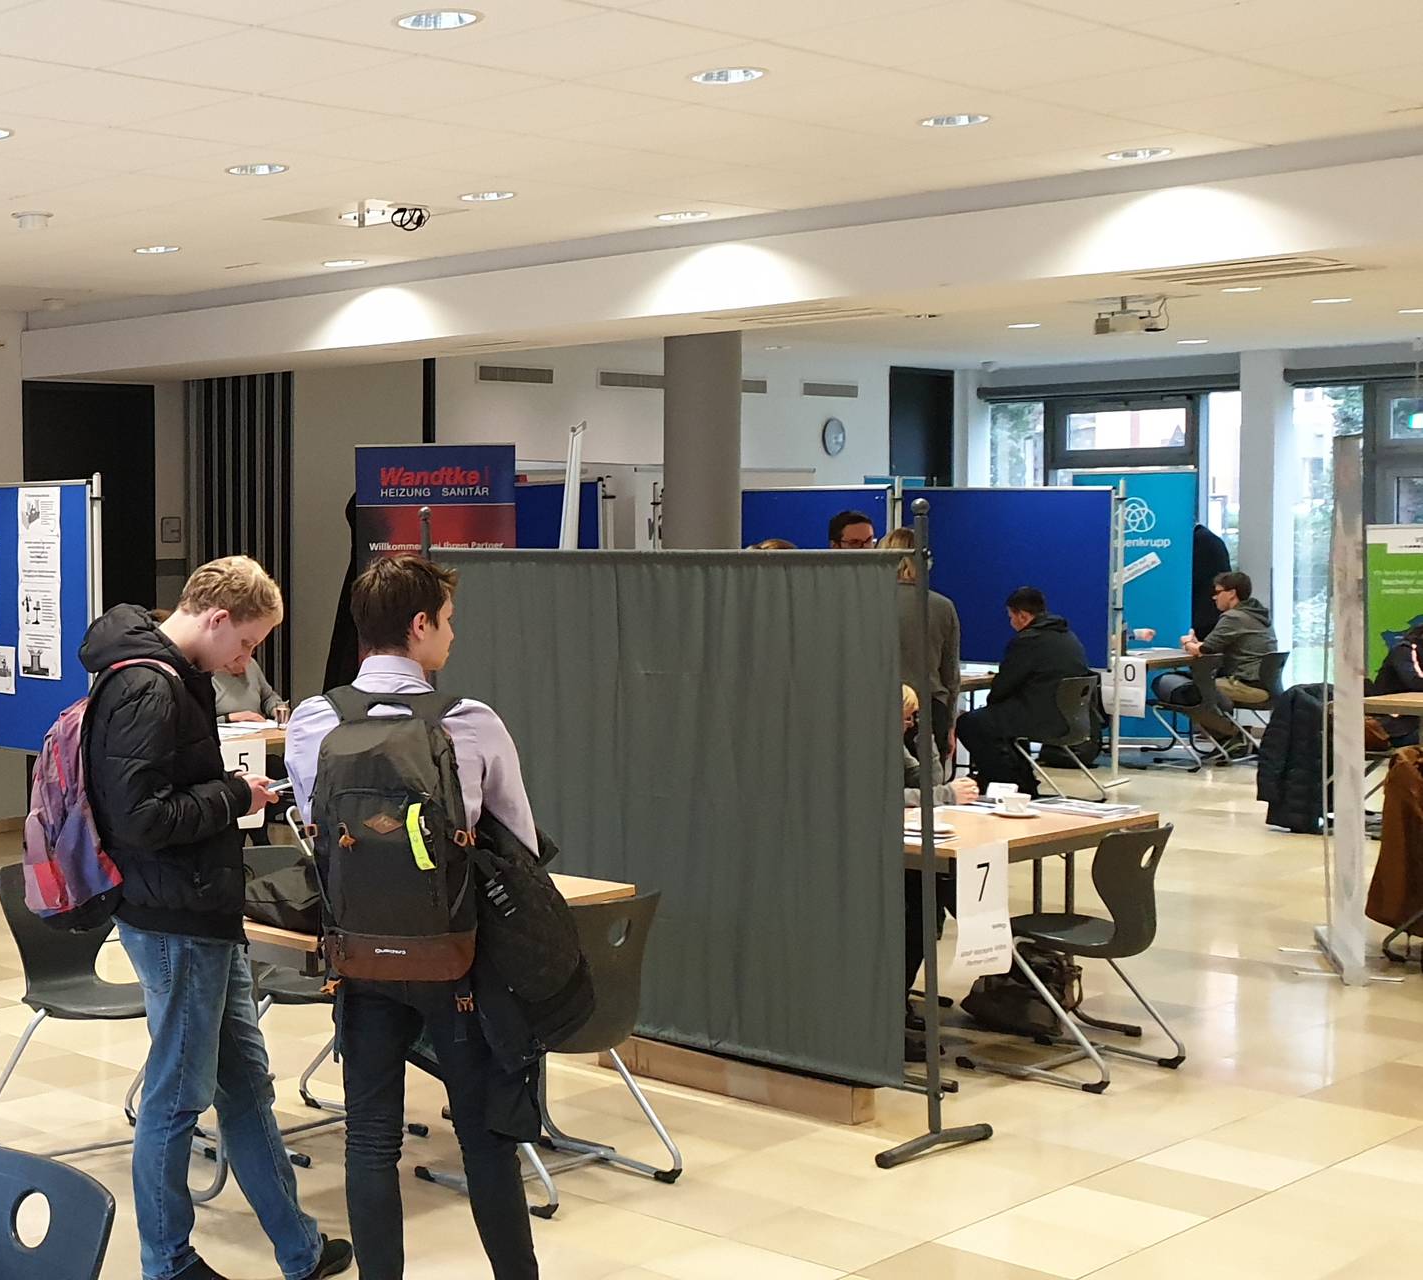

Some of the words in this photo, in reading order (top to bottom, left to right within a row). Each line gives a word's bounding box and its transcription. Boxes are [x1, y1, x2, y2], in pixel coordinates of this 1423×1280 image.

[380, 465, 480, 486] Wandtke
[380, 487, 431, 498] HEIZUNG
[441, 486, 489, 497] SANITÄR
[369, 543, 422, 551] Willkomme
[238, 752, 249, 772] 5
[977, 862, 990, 902] 7
